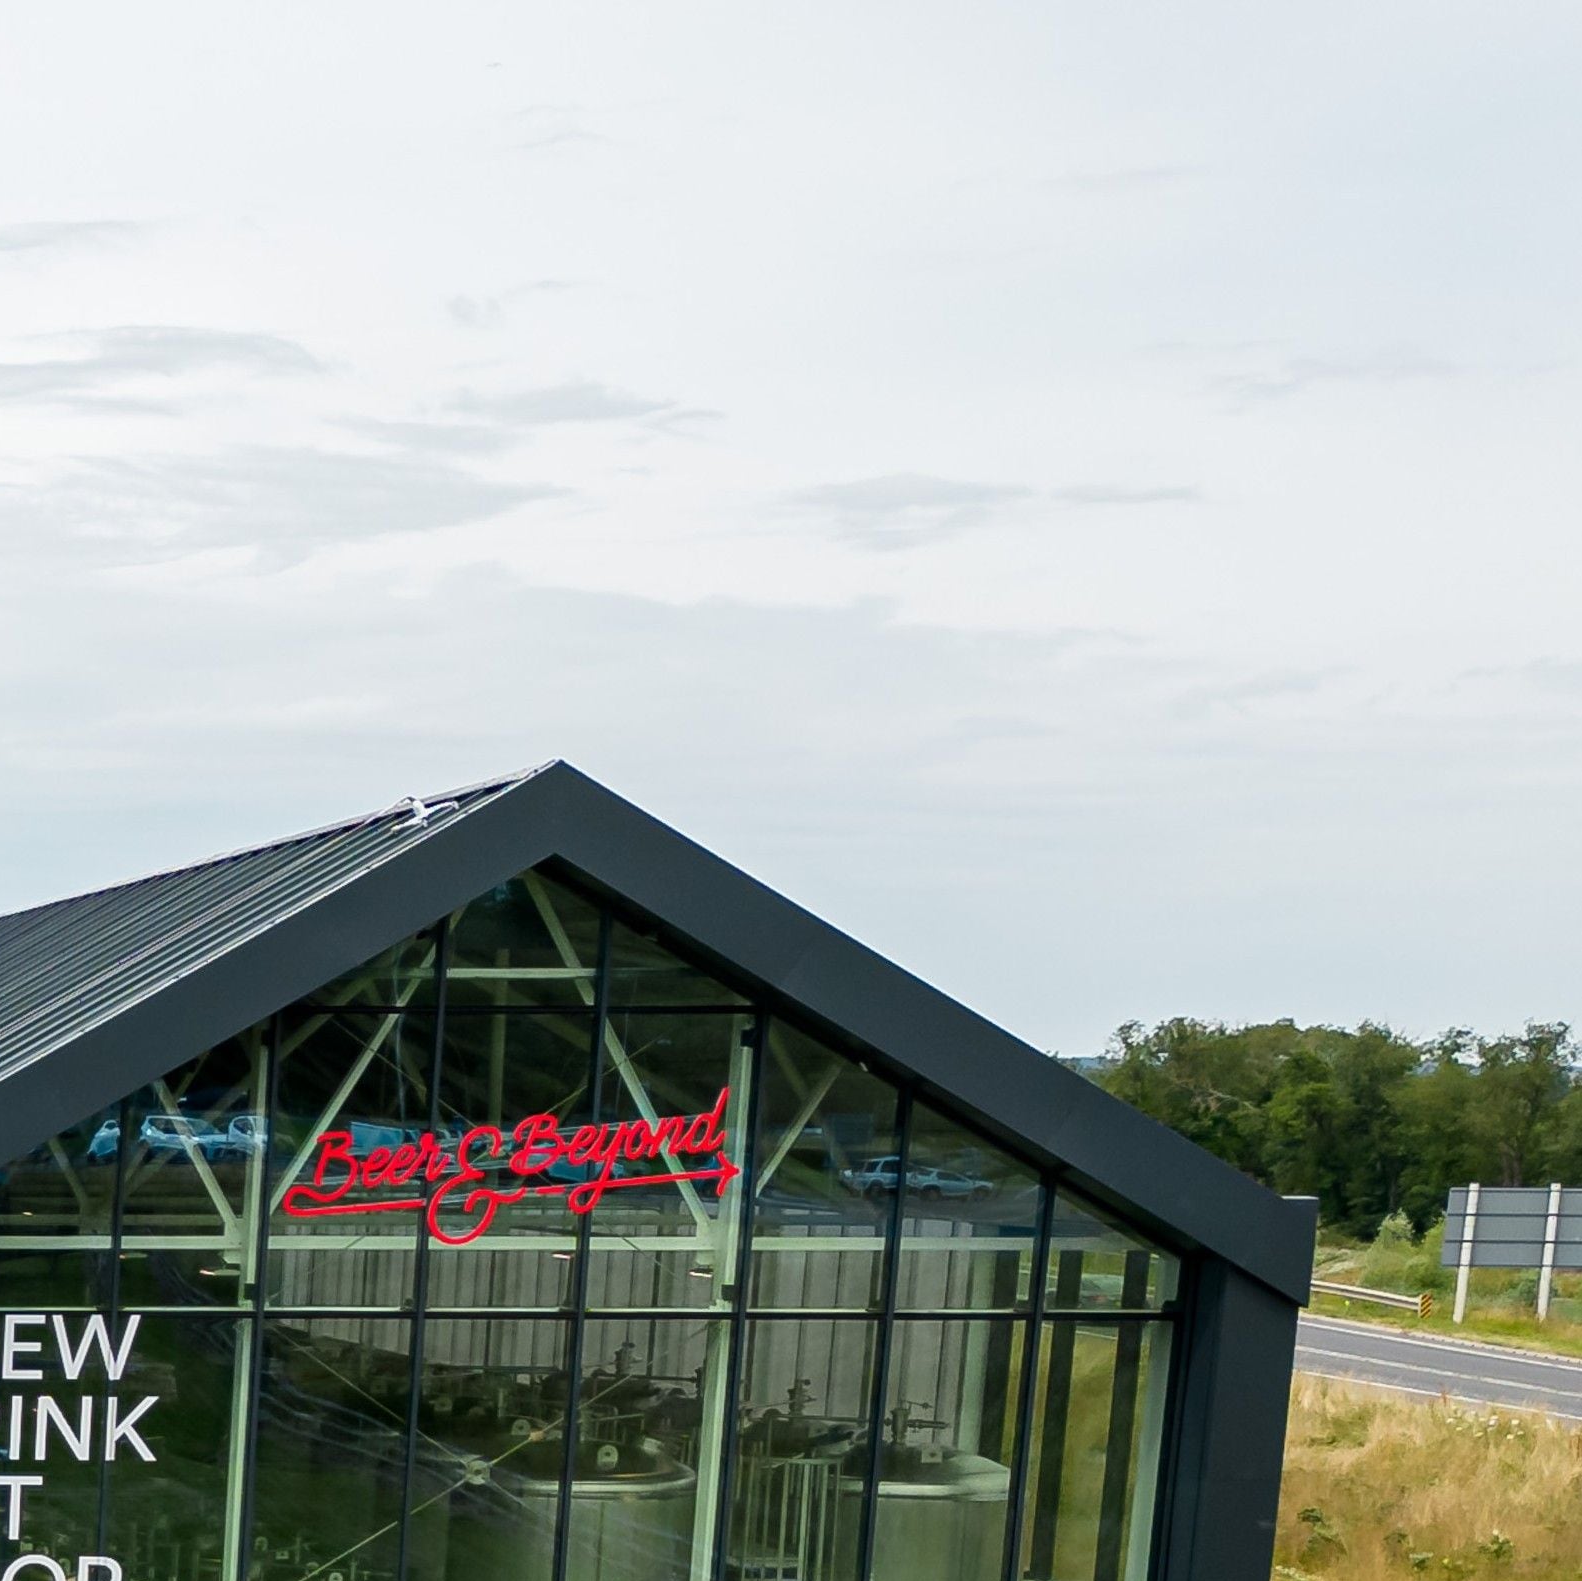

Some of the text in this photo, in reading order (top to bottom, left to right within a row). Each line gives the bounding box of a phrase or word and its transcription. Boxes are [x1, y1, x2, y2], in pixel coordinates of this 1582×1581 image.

[297, 1087, 734, 1245] Beer & Beyond
